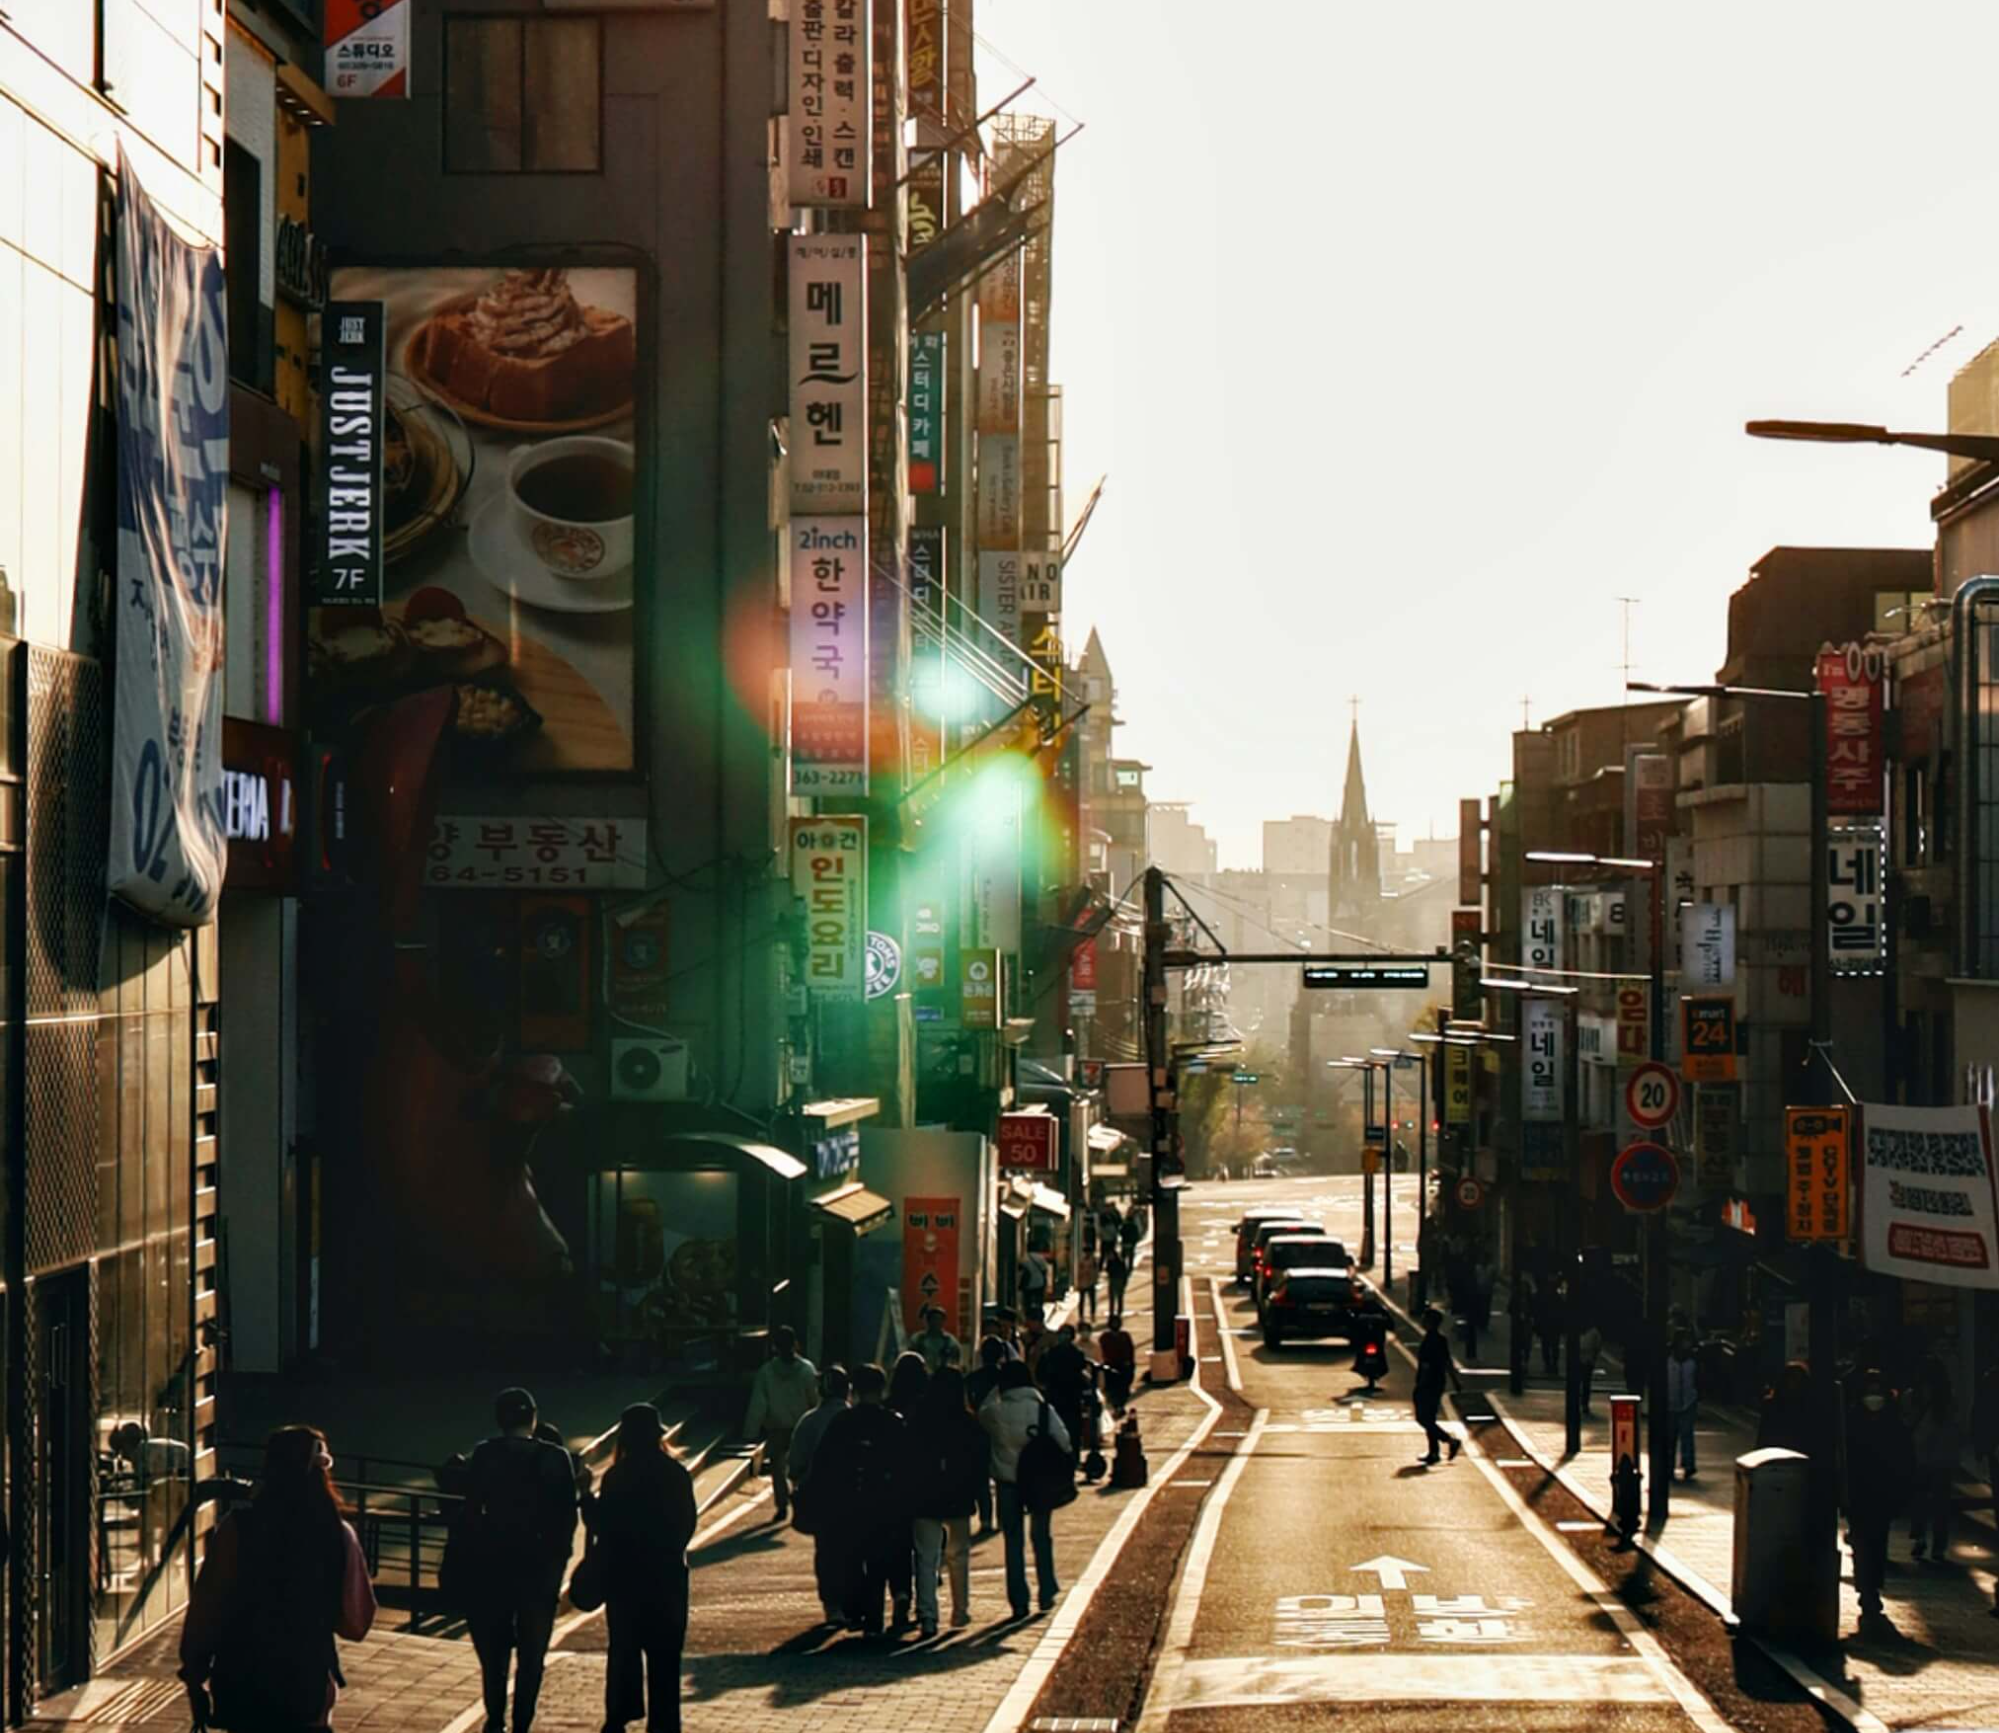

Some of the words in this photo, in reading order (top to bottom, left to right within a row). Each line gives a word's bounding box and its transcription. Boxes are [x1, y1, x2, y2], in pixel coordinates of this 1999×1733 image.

[338, 43, 395, 58] 스튜디오
[798, 282, 859, 446] 메르헨
[329, 366, 373, 462] JUST
[328, 465, 371, 560] JERK
[799, 527, 857, 550] 2inch
[332, 569, 366, 590] 7F
[999, 560, 1016, 614] SISTER
[1027, 563, 1058, 581] NO
[811, 557, 845, 680] 한약국
[1829, 686, 1873, 791] 명동사주
[475, 823, 622, 863] 부동산
[810, 856, 845, 979] 인도요리
[1829, 849, 1876, 950] 네일
[869, 937, 897, 969] TOMS
[1691, 1019, 1726, 1048] 24
[1531, 1031, 1555, 1087] 네일
[1641, 1082, 1665, 1108] 20
[1002, 1124, 1046, 1140] SALE
[1010, 1144, 1037, 1162] 50
